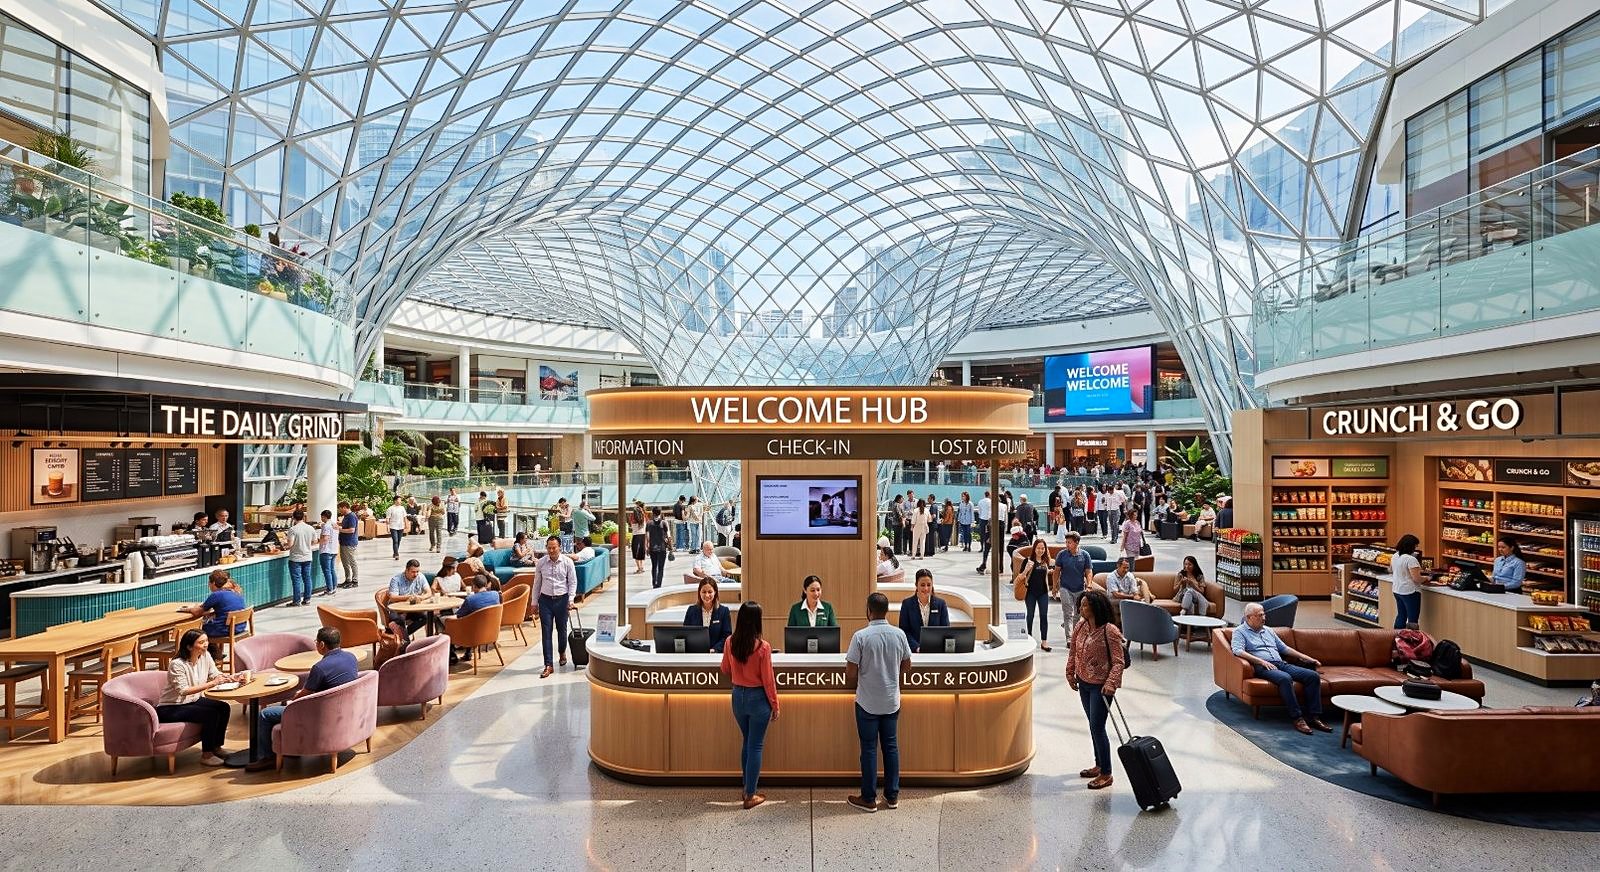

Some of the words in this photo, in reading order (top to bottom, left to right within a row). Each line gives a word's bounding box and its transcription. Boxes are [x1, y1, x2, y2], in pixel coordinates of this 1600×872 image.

[1066, 363, 1129, 379] WELCOME
[1066, 376, 1129, 392] WELCOME
[690, 396, 852, 424] WELCOME
[862, 396, 928, 424] HUB
[1322, 404, 1429, 436] CRUNCH
[1436, 402, 1459, 432] &
[1466, 398, 1520, 431] GO
[160, 404, 216, 435] THE
[222, 410, 284, 437] DAILY
[288, 413, 342, 439] GRIND
[594, 439, 684, 456] NFORMATION
[767, 439, 850, 455] CHECK-IN
[931, 439, 973, 455] LOST
[975, 439, 987, 455] &
[990, 439, 1027, 455] FOUND
[618, 668, 719, 685] INFORMATION
[775, 672, 846, 686] CHECK-IN
[903, 672, 941, 686] LOST
[944, 671, 955, 686] &
[959, 669, 1008, 685] FOUND
